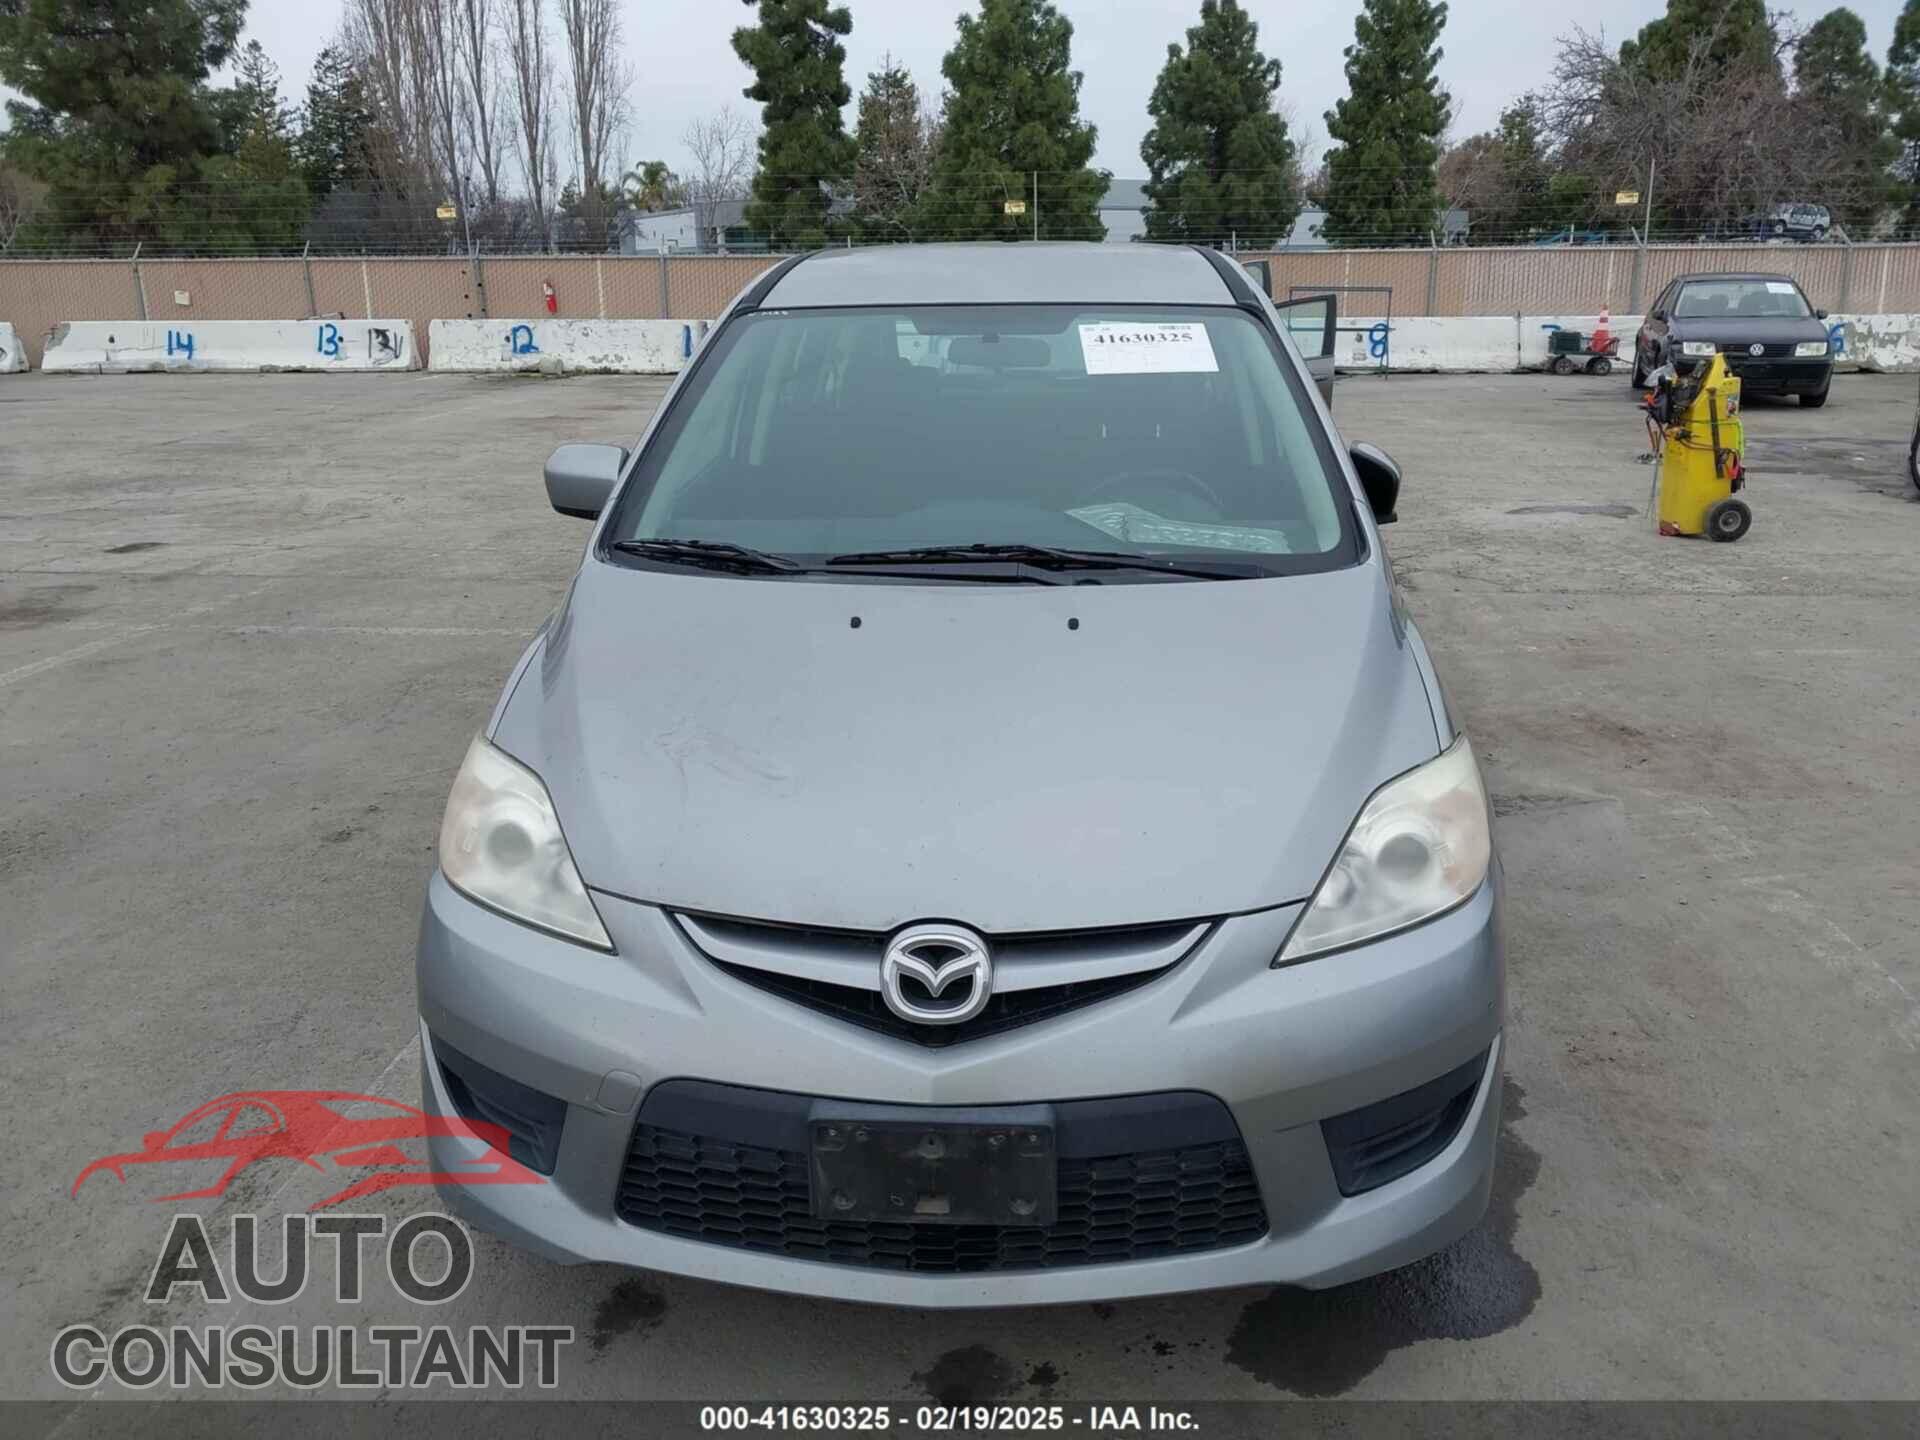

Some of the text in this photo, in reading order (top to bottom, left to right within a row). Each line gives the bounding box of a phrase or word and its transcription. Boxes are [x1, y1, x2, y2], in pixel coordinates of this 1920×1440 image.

[167, 330, 193, 360] 14
[317, 323, 339, 356] 13
[1093, 333, 1193, 344] 41630325
[1369, 323, 1388, 358] 8
